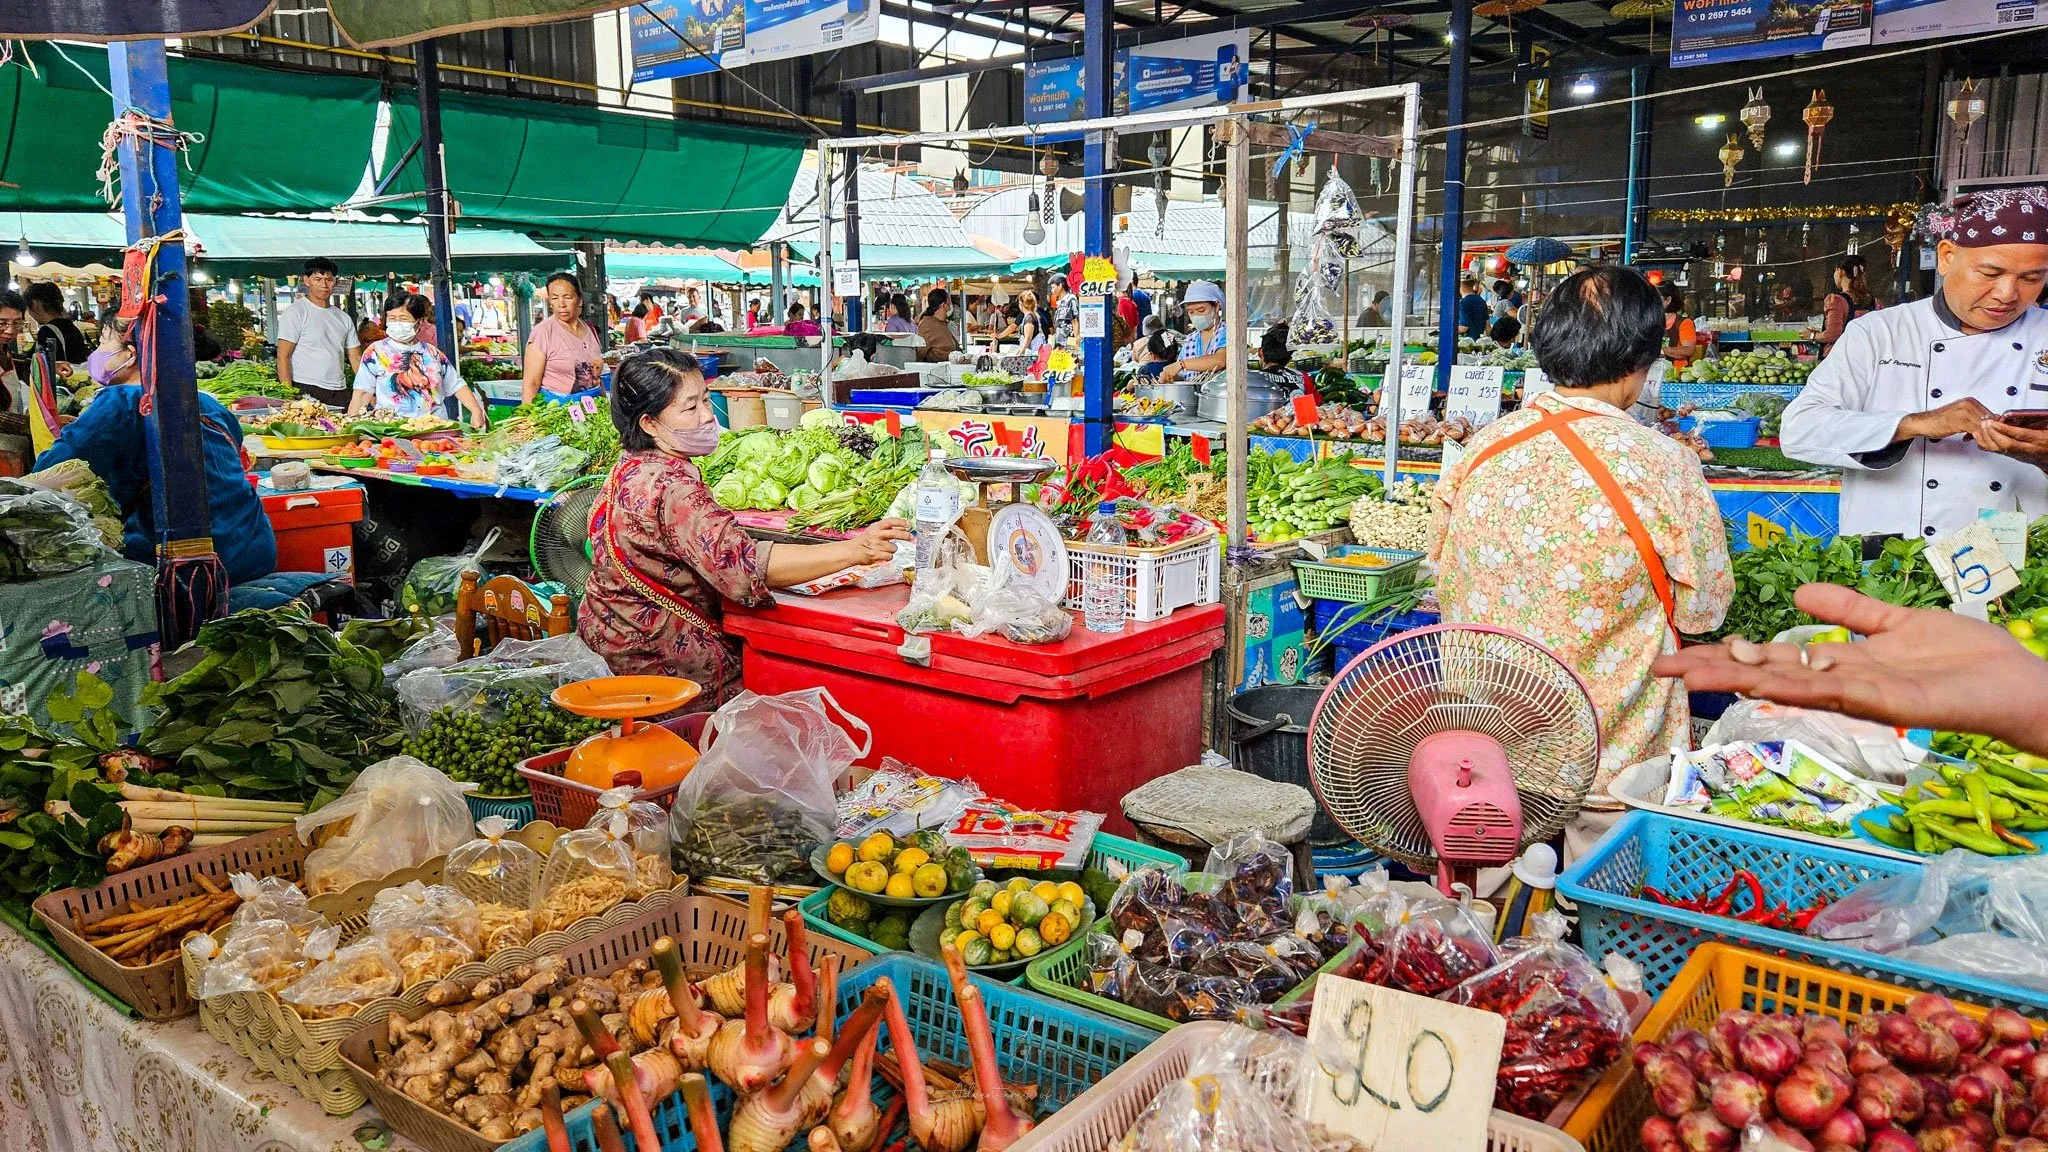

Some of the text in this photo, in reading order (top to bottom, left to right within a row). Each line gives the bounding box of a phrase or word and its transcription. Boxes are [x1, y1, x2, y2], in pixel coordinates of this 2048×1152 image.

[1700, 6, 1752, 21] 0 2697 5454
[644, 27, 649, 37] 0
[1080, 280, 1115, 296] SALE
[1042, 370, 1071, 382] SALE
[1487, 369, 1494, 381] 2
[1408, 385, 1429, 397] 140
[1477, 386, 1499, 398] 135
[1951, 545, 1991, 595] 5
[1332, 998, 1455, 1113] 20
